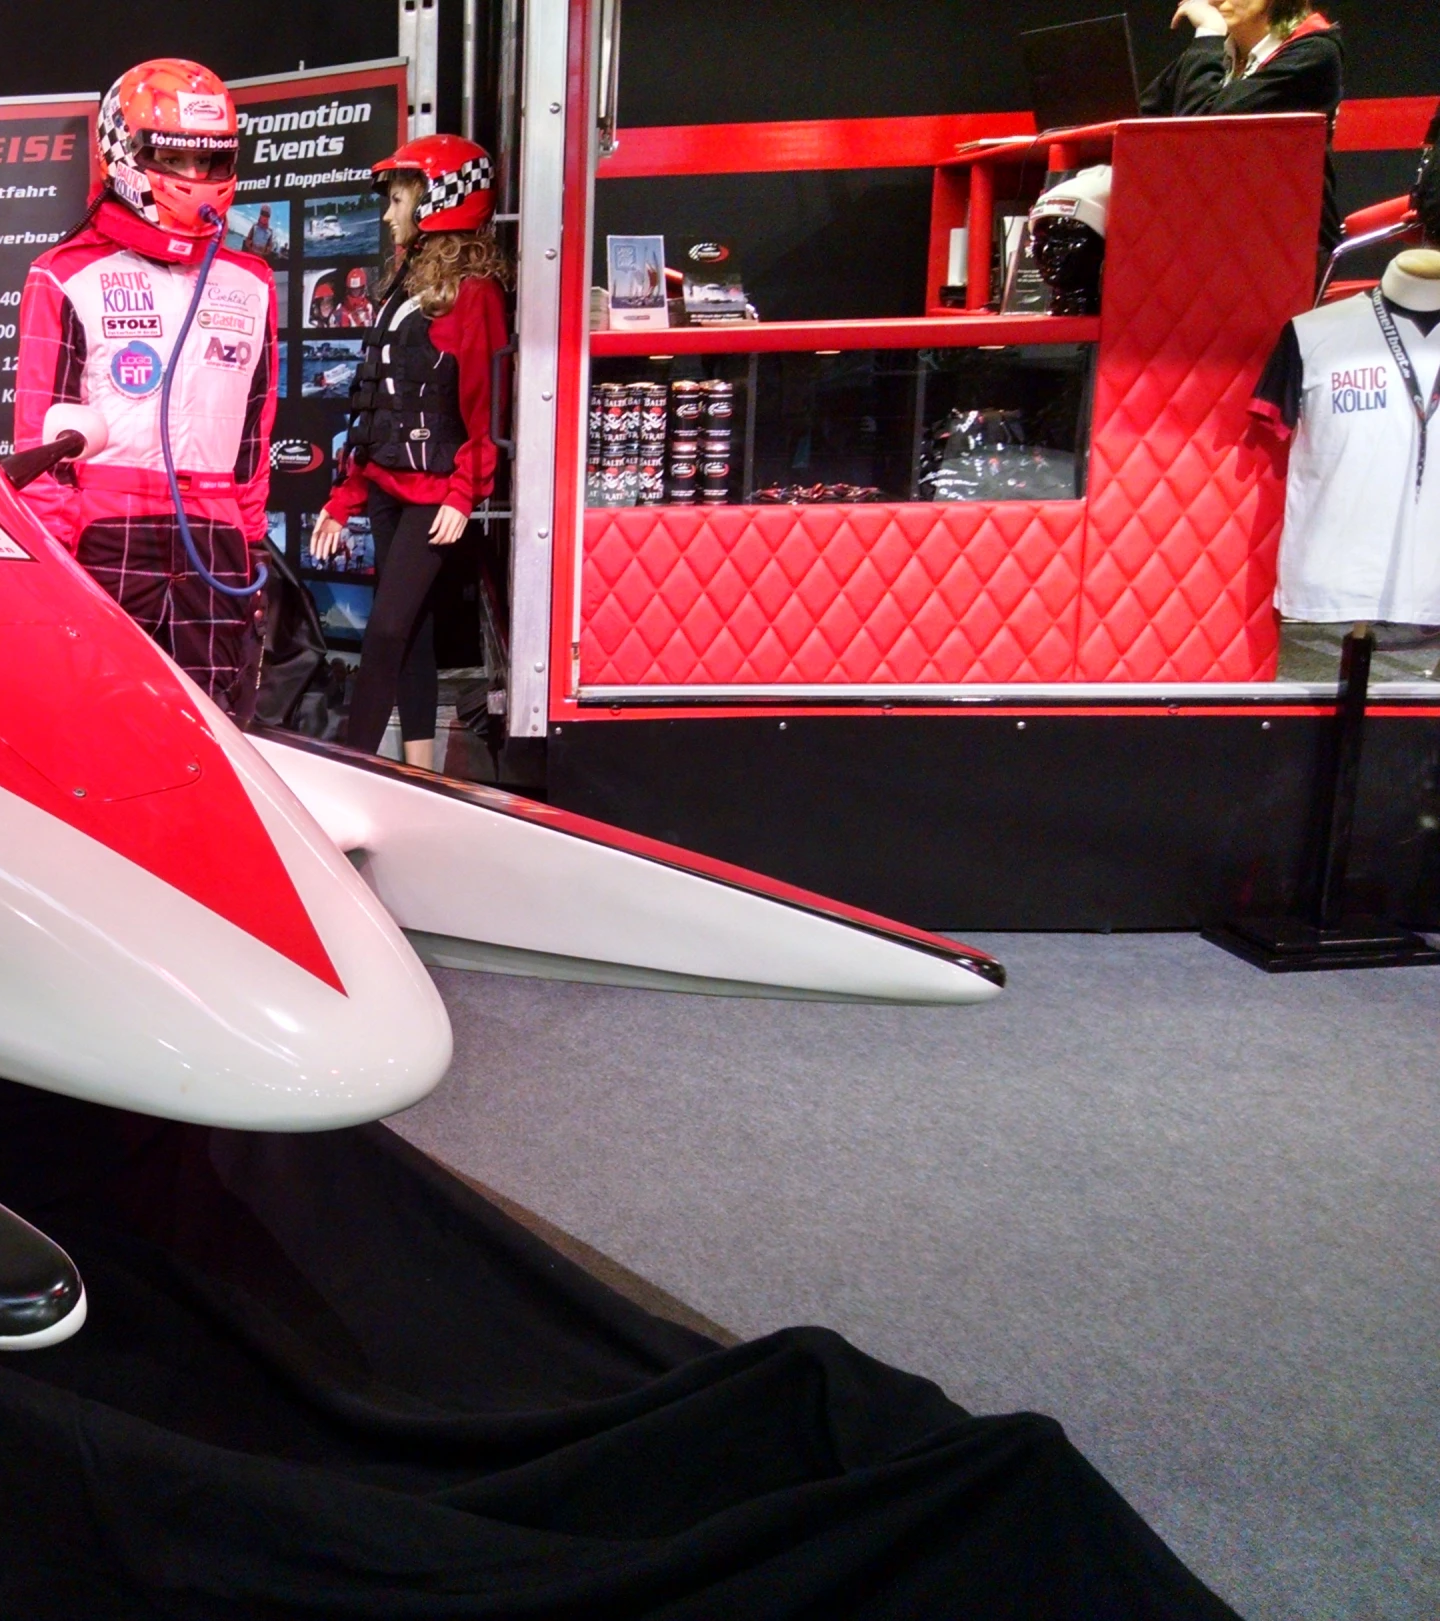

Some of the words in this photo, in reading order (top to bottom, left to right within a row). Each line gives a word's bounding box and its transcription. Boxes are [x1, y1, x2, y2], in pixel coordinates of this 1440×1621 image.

[237, 101, 372, 137] Promotion
[253, 134, 345, 164] Events
[273, 174, 282, 188] 1
[284, 167, 374, 189] Doppelsitze
[100, 271, 152, 291] BALTIC
[102, 288, 155, 312] KÖLLN
[106, 319, 158, 330] STOLZ
[212, 313, 246, 330] Castrol
[120, 355, 153, 365] LOGO
[120, 364, 153, 385] FIT
[1331, 366, 1387, 392] BALTIC
[1331, 388, 1387, 414] KÖLLN
[277, 453, 312, 462] Powerboat
